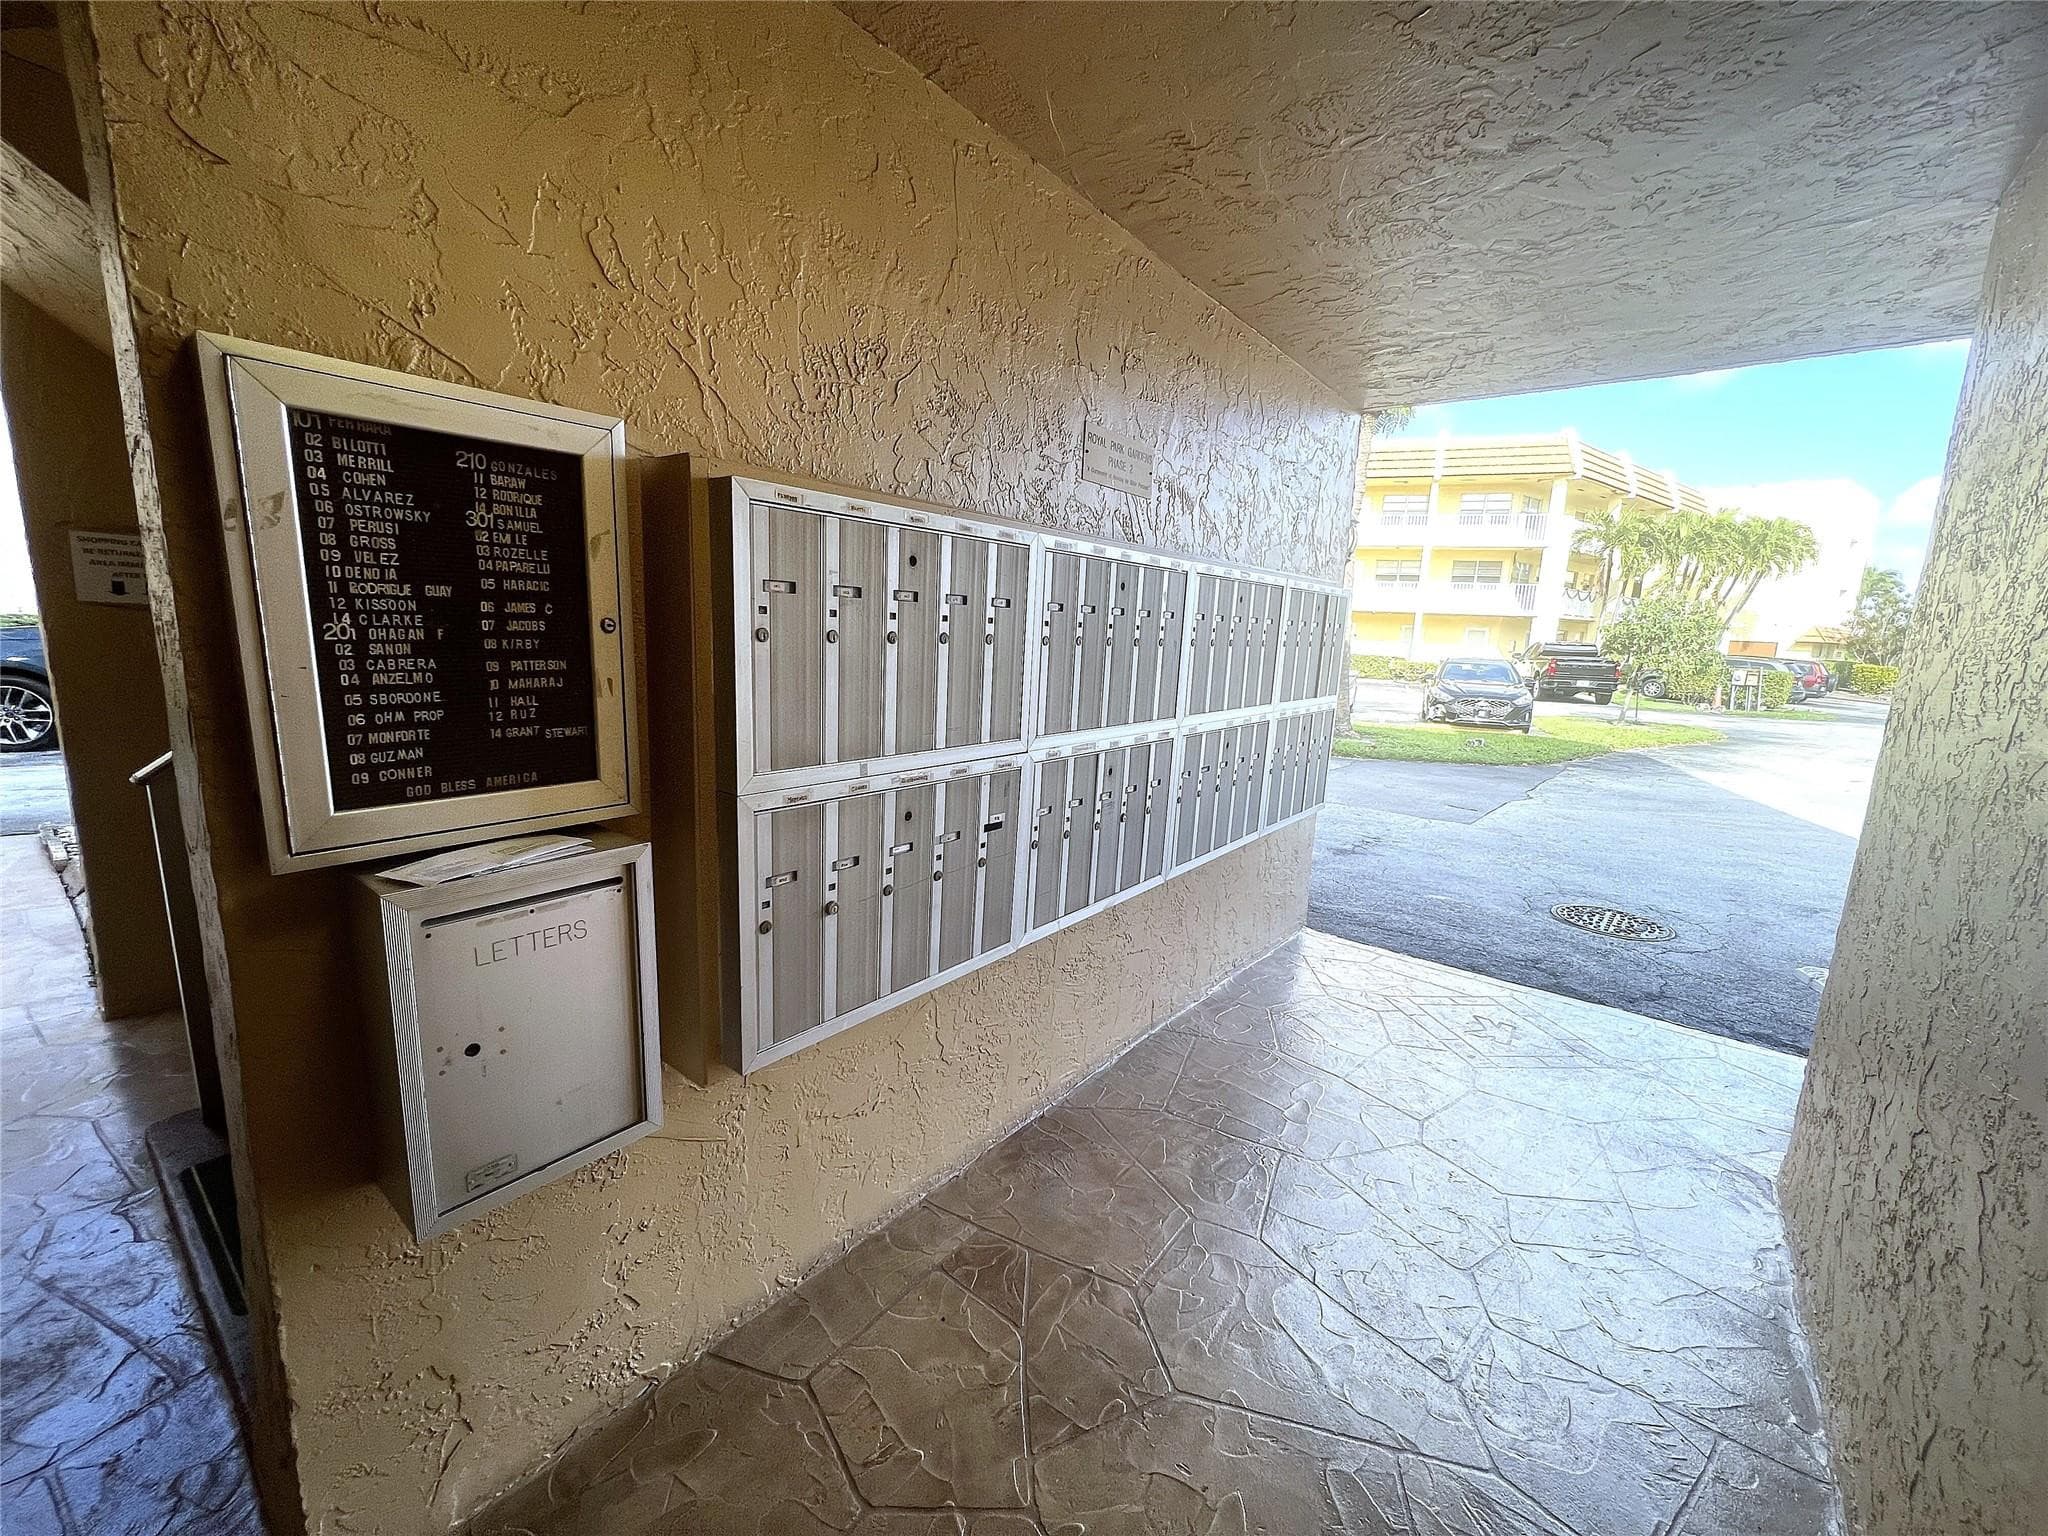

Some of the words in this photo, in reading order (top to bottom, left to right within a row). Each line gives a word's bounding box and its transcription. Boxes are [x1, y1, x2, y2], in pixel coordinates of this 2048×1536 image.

[305, 432, 323, 446] 02
[332, 436, 386, 456] BILOTTI
[1087, 432, 1107, 448] ROYAL
[1110, 441, 1125, 454] PARK
[304, 449, 323, 462] 03
[337, 453, 394, 472] MERRILL
[456, 451, 486, 470] 210
[490, 461, 558, 480] GONZALES
[1107, 456, 1127, 472] PHASE
[307, 465, 326, 480] 04
[343, 471, 386, 486] COHEN
[474, 472, 483, 484] 11
[309, 483, 330, 497] 05
[342, 487, 415, 506] ALVAREZ
[474, 487, 487, 499] 12
[315, 500, 334, 513] 06
[345, 504, 431, 523] OSTROWSKY
[475, 502, 486, 513] 14
[493, 503, 537, 519] BONILLA
[318, 516, 335, 529] 07
[350, 519, 399, 535] PERUSI
[465, 510, 494, 529] 301
[497, 519, 543, 534] SAMUEL
[320, 532, 337, 545] 08
[350, 535, 396, 550] GROSS
[475, 530, 489, 543] 02
[320, 549, 342, 562] 09
[354, 551, 400, 565] VELEZ
[476, 545, 490, 557] 03
[494, 546, 548, 561] ROZELLE
[326, 565, 341, 578] 10
[478, 559, 493, 571] 04
[328, 581, 337, 593] 11
[425, 585, 452, 597] GUAY
[481, 578, 496, 590] 05
[330, 597, 347, 610] 12
[355, 598, 417, 611] KISSOON
[480, 601, 495, 613] 06
[504, 602, 536, 614] JAMES
[545, 603, 553, 615] C
[333, 612, 350, 625] 14
[359, 614, 423, 626] CLARKE
[481, 620, 495, 631] 07
[506, 620, 546, 631] JACOBS
[323, 623, 357, 640] 201
[369, 629, 424, 640] OHAGAN
[437, 629, 444, 640] F
[335, 643, 354, 655] 02
[369, 643, 412, 655] SANON
[484, 639, 497, 649] 08
[502, 639, 540, 649] KIRBY
[339, 659, 355, 671] 03
[366, 658, 437, 671] CABRERA
[486, 661, 499, 672] 09
[510, 660, 567, 671] PATTERSON
[341, 674, 360, 686] 04
[372, 672, 433, 685] ANZELMO
[490, 679, 499, 691] 10
[508, 677, 564, 689] MAHARAJ
[344, 694, 362, 706] 05
[369, 691, 441, 705] SBORDONE
[488, 697, 498, 708] 11
[510, 696, 539, 707] HALL
[347, 713, 366, 726] 06
[375, 711, 405, 725] OHM
[414, 710, 445, 722] PROP
[488, 711, 503, 722] 12
[510, 708, 537, 720] RUZ
[347, 733, 363, 746] 07
[368, 729, 431, 744] MONFORTE
[490, 728, 501, 739] 14
[505, 726, 541, 738] GRANT
[545, 726, 589, 739] STEWART
[350, 753, 366, 765] 08
[370, 747, 424, 763] GUZMAN
[352, 772, 369, 785] 09
[379, 766, 432, 782] CONNER
[406, 784, 432, 797] GOD
[441, 779, 476, 793] BLESS
[486, 771, 538, 788] AMERICA
[474, 919, 588, 967] LETTERS
